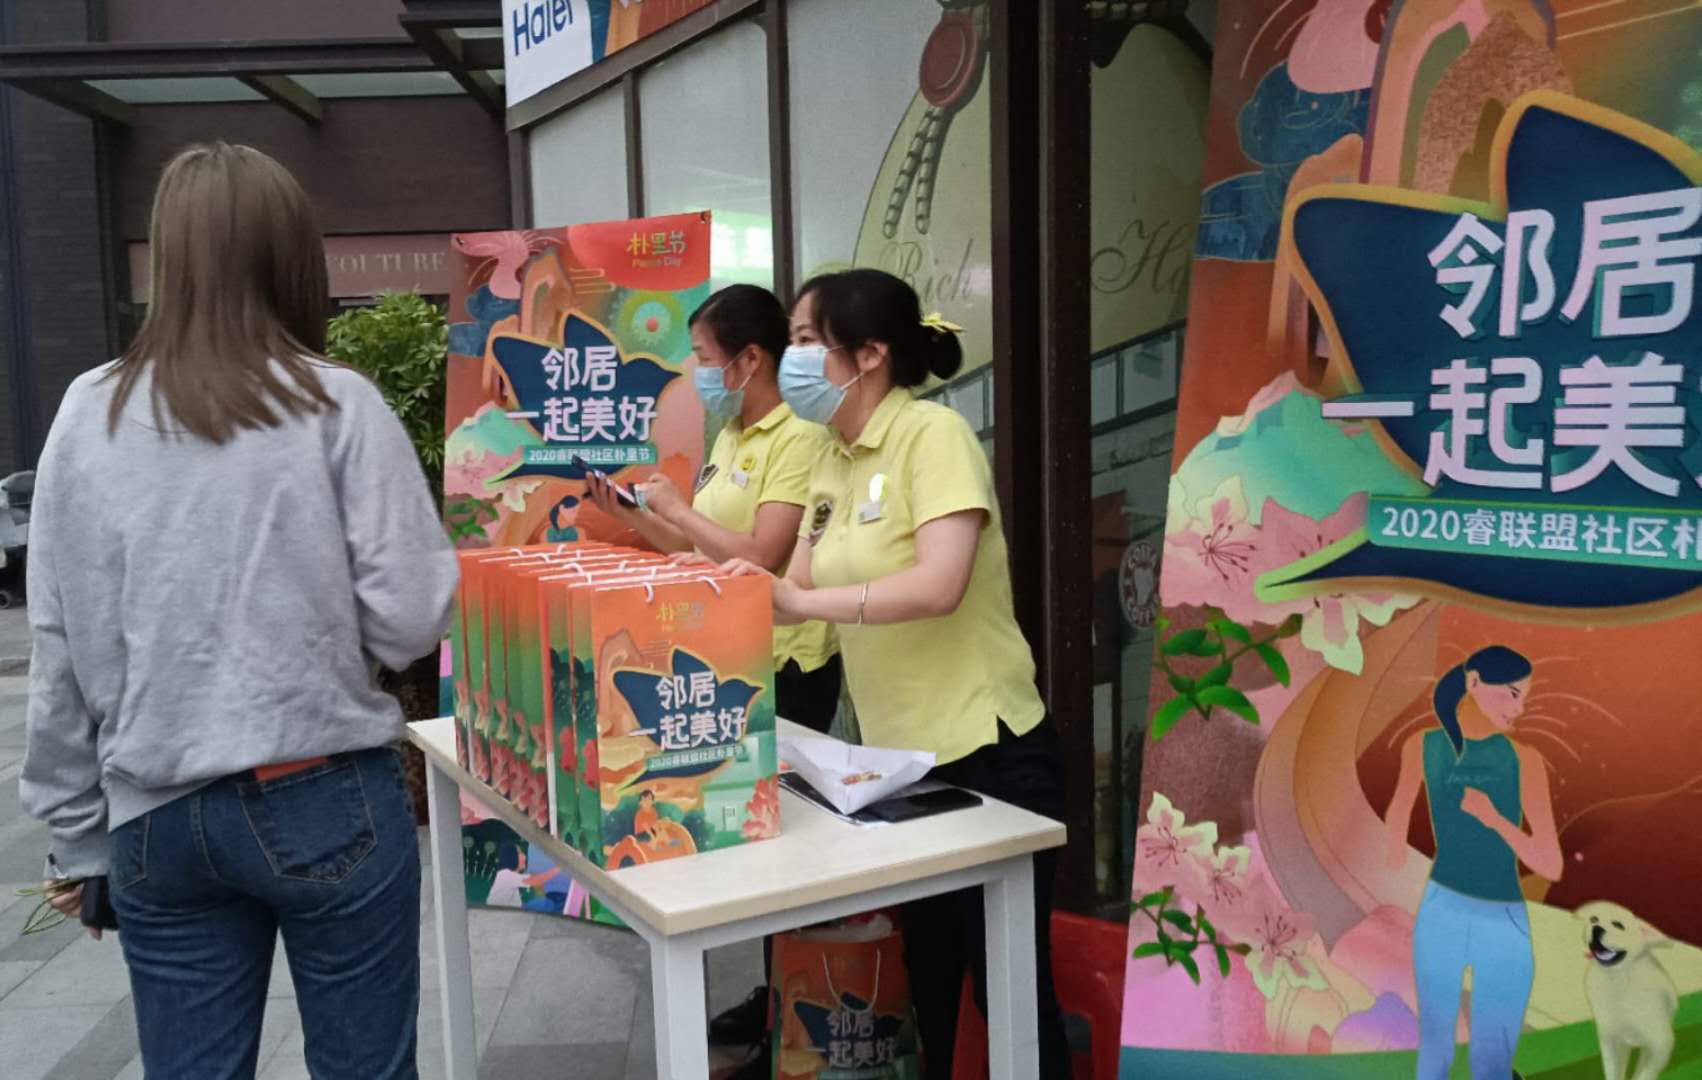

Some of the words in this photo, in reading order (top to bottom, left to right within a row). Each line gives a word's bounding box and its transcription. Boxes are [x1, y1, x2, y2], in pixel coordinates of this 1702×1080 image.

[513, 0, 573, 56] Haier
[1428, 186, 1702, 337] 邻居
[541, 345, 618, 391] 邻居
[505, 396, 657, 442] 一起美好
[1322, 351, 1702, 496] 一起美
[656, 670, 715, 710] 邻居
[629, 706, 747, 750] 一起美好
[826, 1007, 875, 1037] 邻居
[806, 1038, 897, 1067] 一起美好
